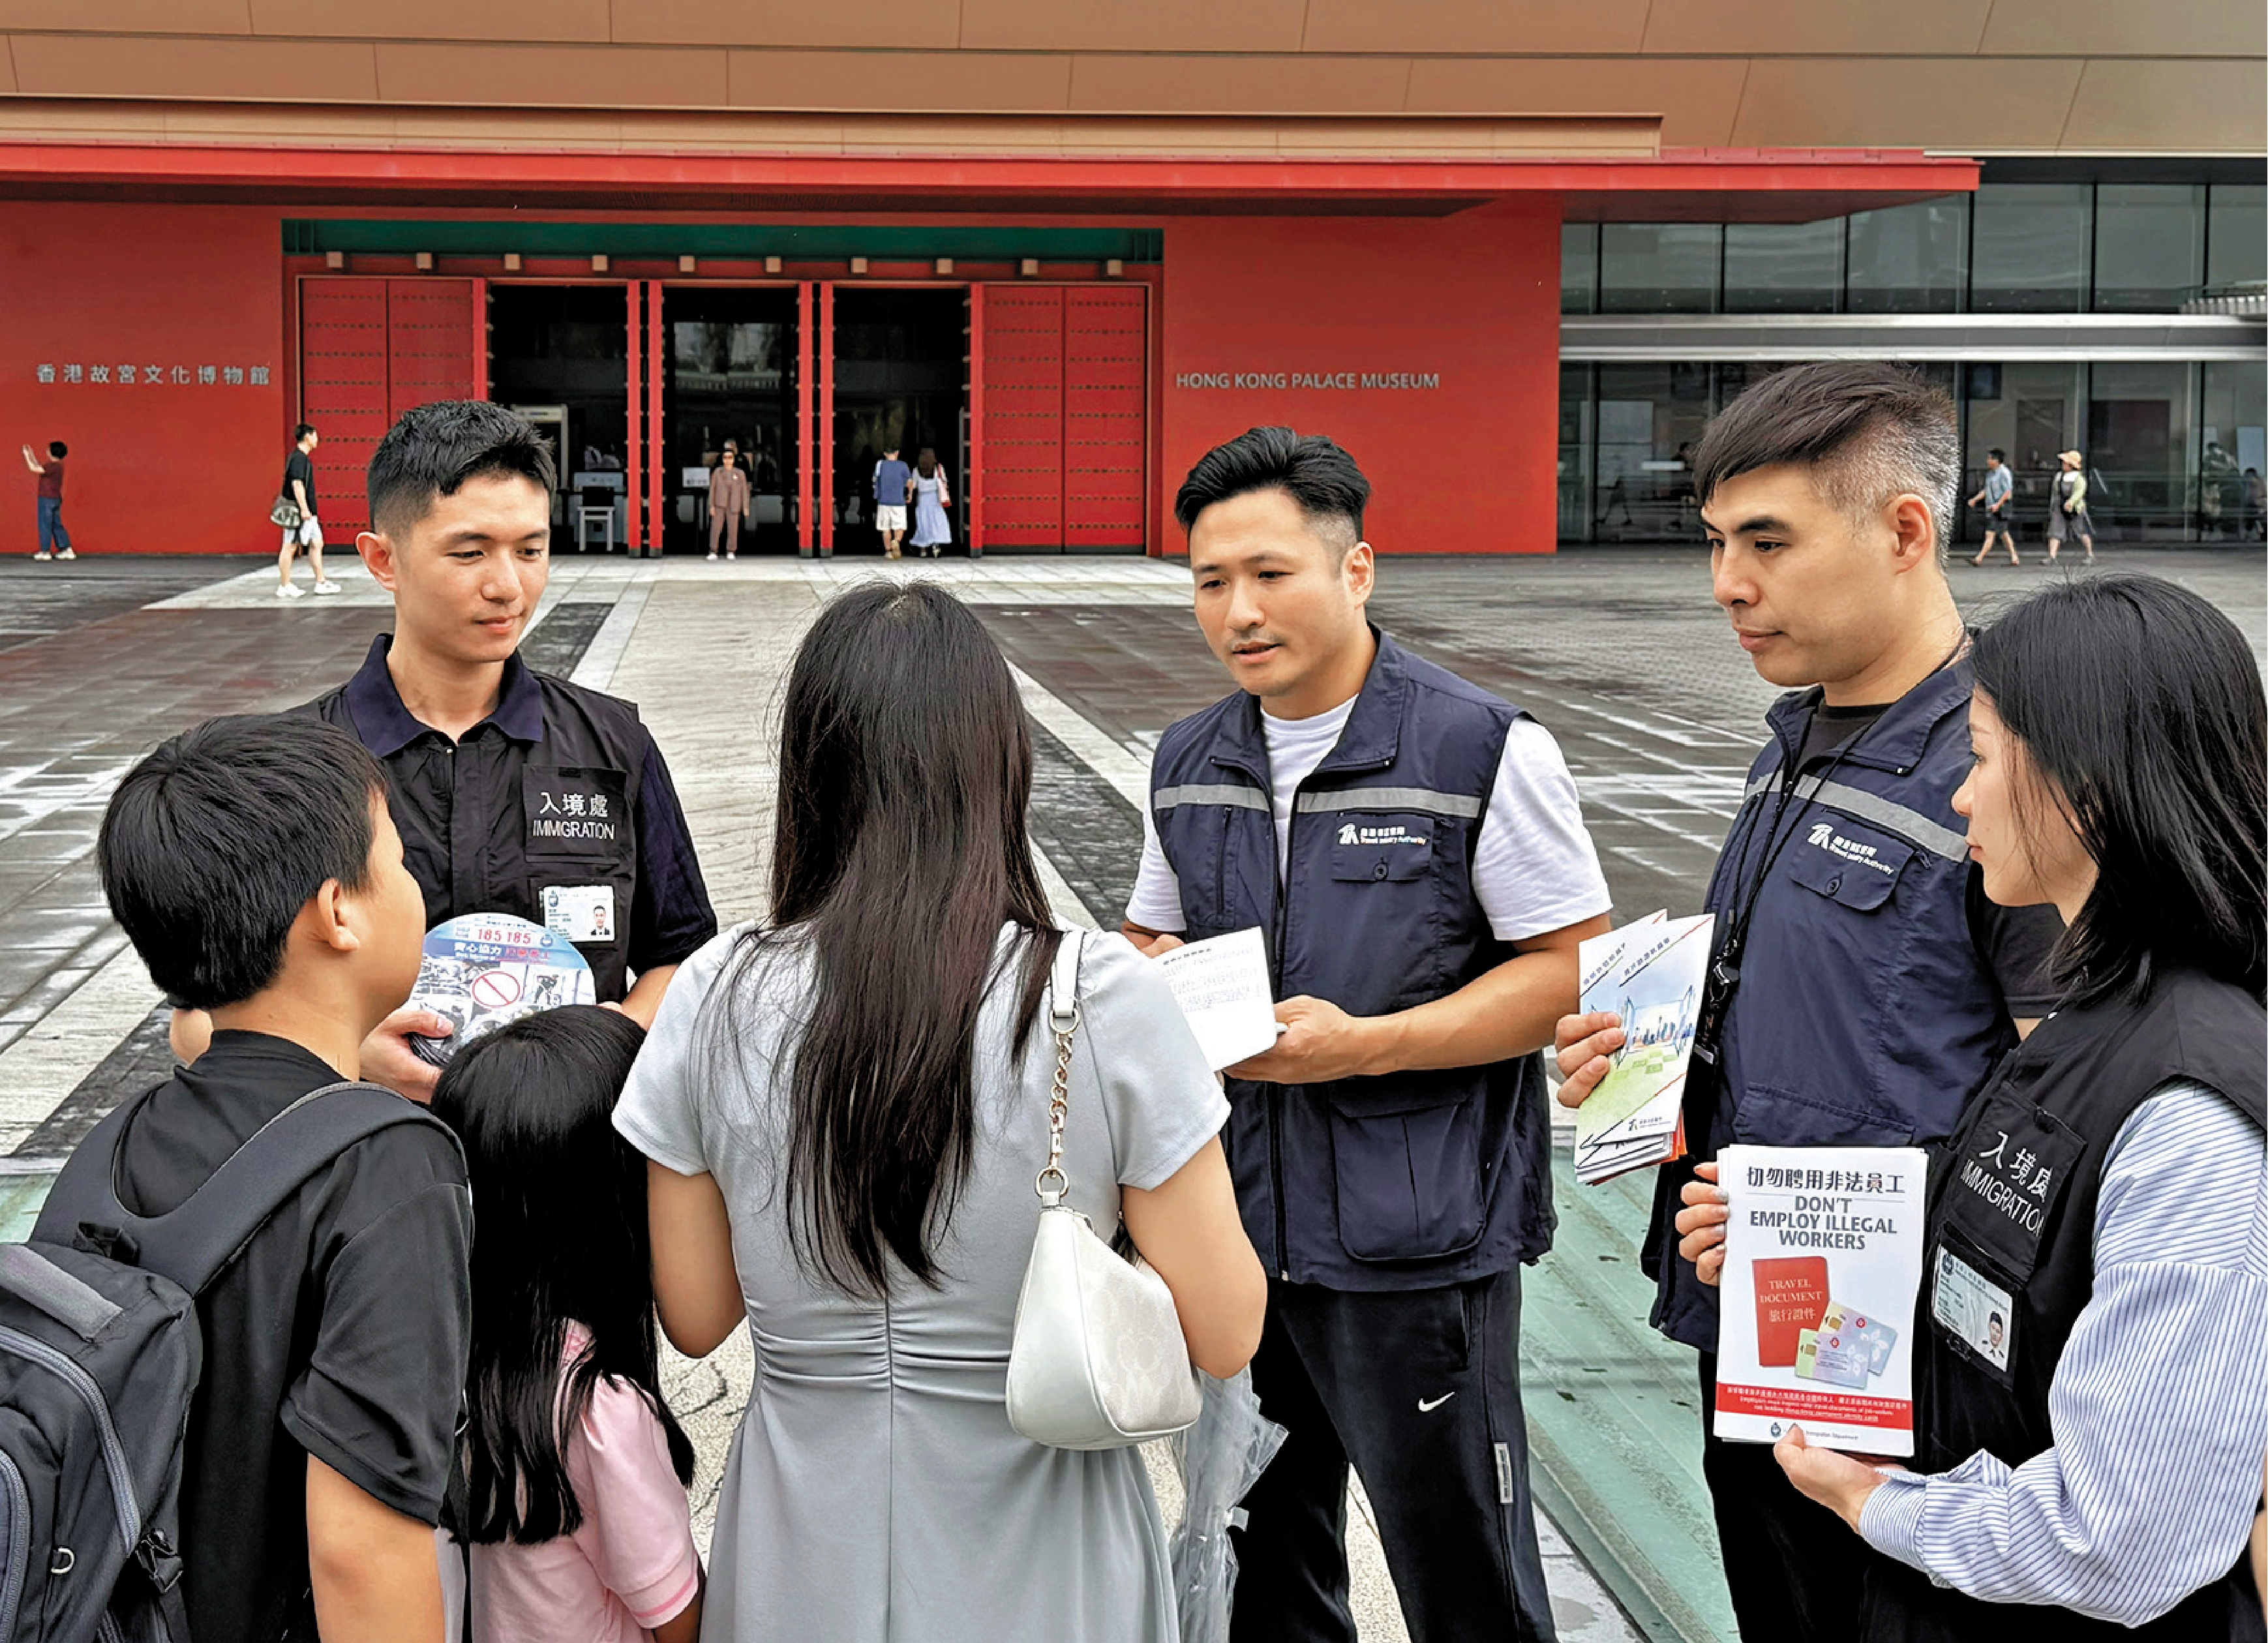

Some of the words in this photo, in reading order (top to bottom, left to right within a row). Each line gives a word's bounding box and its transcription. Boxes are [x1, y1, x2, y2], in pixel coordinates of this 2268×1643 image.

[37, 364, 269, 384] 香港故宮文化博物館
[1176, 373, 1230, 389] HONG
[1235, 373, 1286, 389] KONG
[1292, 373, 1355, 389] PALACE
[1361, 373, 1440, 389] MUSEUM
[540, 792, 608, 817] 入境處
[532, 820, 615, 839] IMMIGRATION
[478, 929, 502, 941] 185
[507, 931, 530, 944] 185
[1747, 1166, 1905, 1193] 切勿聘用非法員工
[1794, 1196, 1853, 1213] DON'T
[1750, 1211, 1820, 1229] EMPLOY
[1826, 1215, 1898, 1233] ILLEGAL
[1779, 1229, 1866, 1250] WORKERS
[1768, 1278, 1811, 1289] TRAVEL
[1760, 1291, 1823, 1303] DOCUMENT
